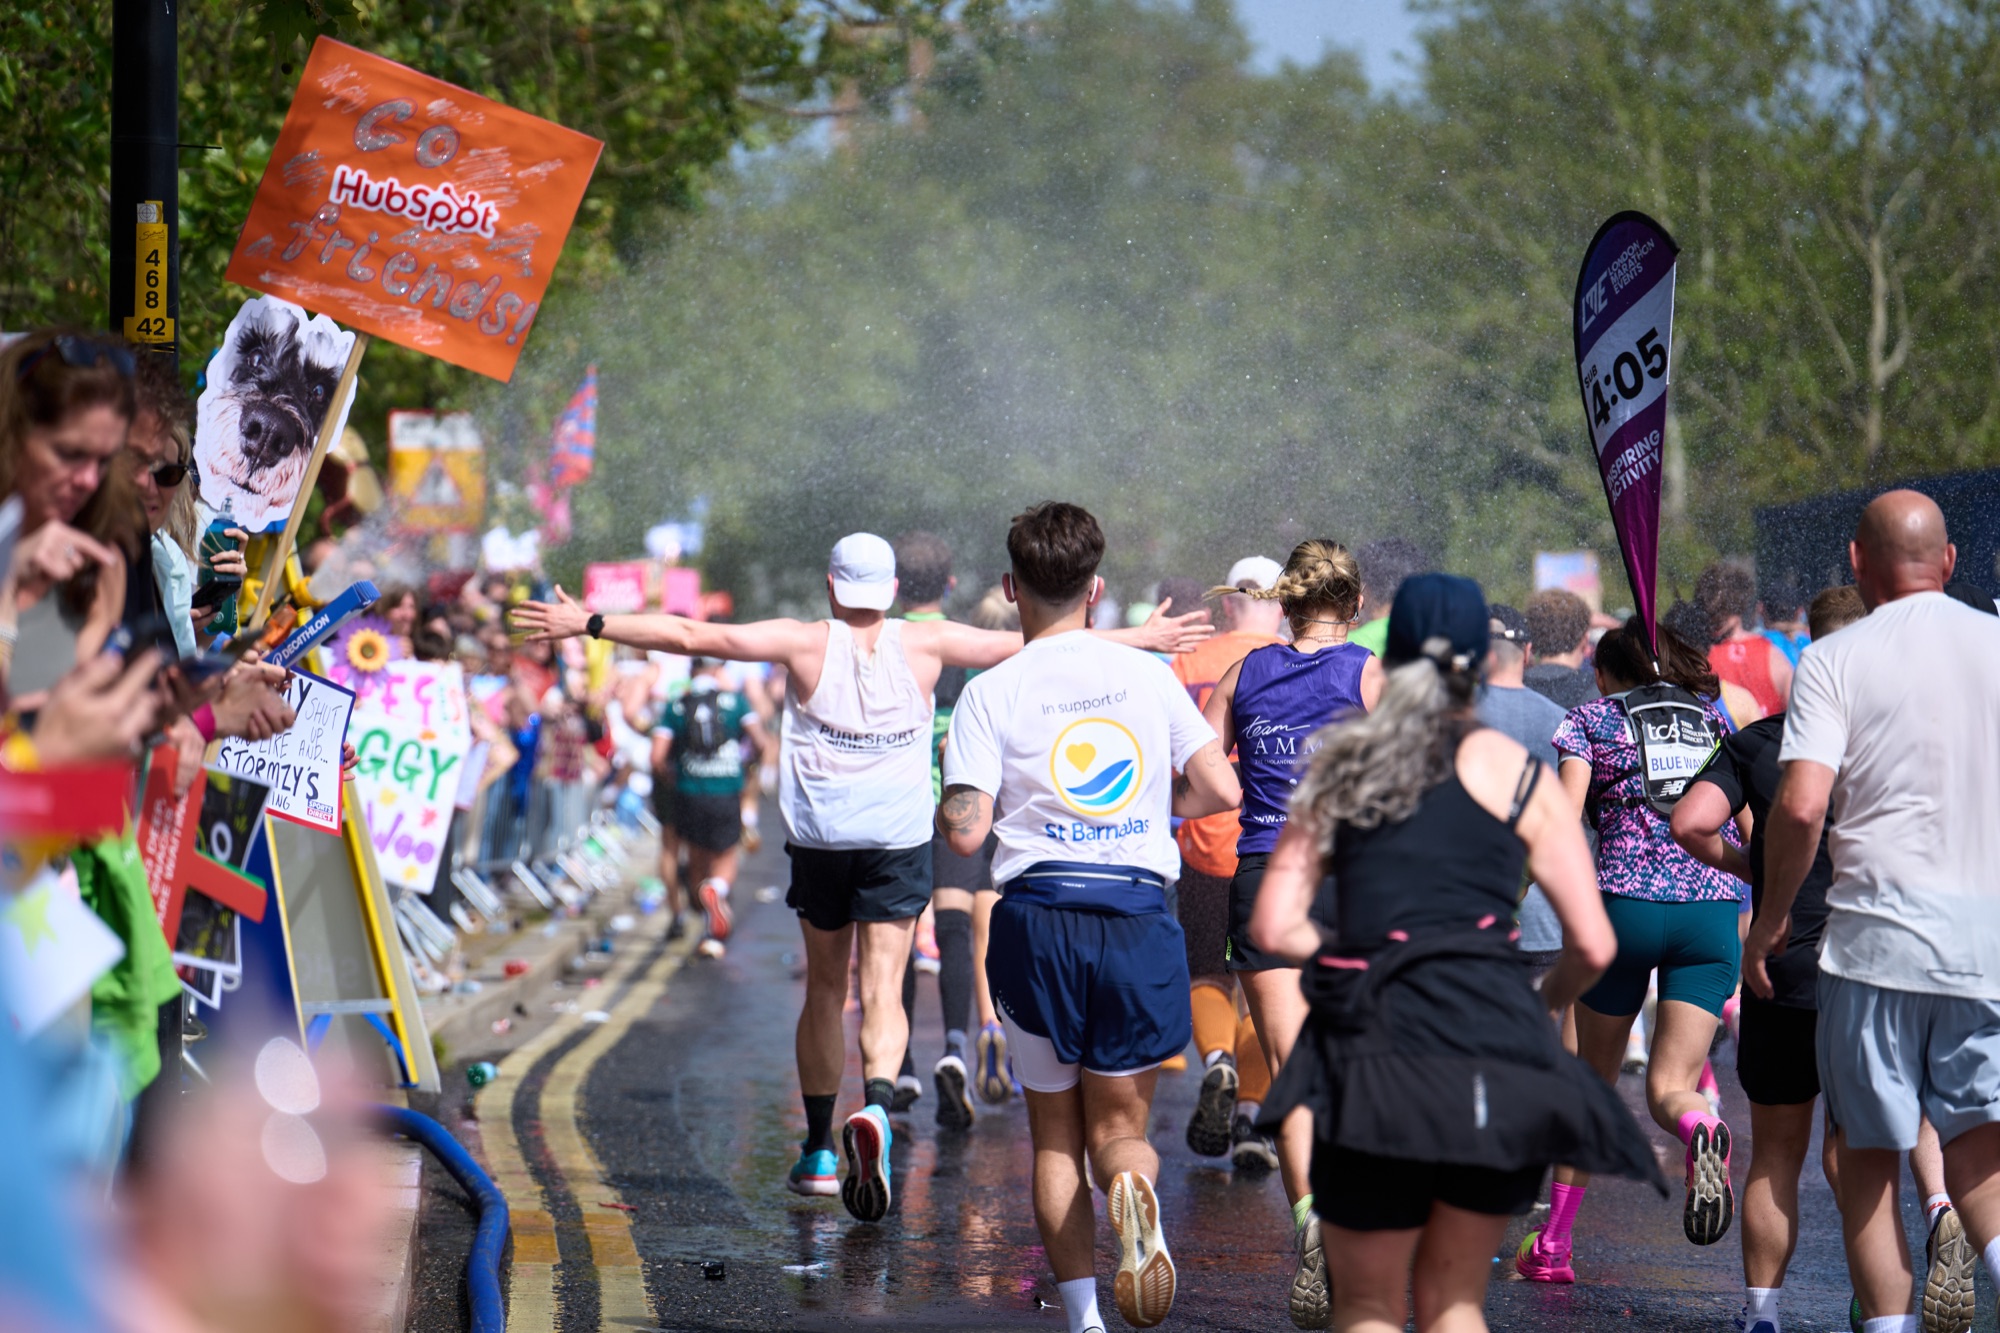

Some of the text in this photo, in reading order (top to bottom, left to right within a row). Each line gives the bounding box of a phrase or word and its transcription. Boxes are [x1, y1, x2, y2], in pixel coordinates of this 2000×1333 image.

[333, 169, 495, 235] HubSpot
[145, 249, 160, 267] 4
[1608, 240, 1640, 276] LONDON
[1610, 239, 1655, 285] MARATHON
[145, 269, 159, 288] 6
[281, 202, 538, 345] friends!
[1613, 262, 1643, 295] EVENTS
[145, 290, 159, 309] 8
[136, 317, 166, 336] 42
[1584, 364, 1598, 388] SUB
[1592, 326, 1668, 429] 4:05
[1606, 429, 1660, 491] INSPIRING
[1611, 447, 1660, 505] ACTIVITY
[282, 614, 330, 660] DECATHLON
[305, 697, 343, 729] SHUT
[1042, 689, 1128, 715] In support of
[310, 727, 324, 746] UP
[1242, 715, 1311, 740] team
[1680, 720, 1694, 730] TATA
[1682, 734, 1704, 743] SERVICES
[217, 746, 320, 800] STORMZY'S
[1651, 755, 1683, 772] BLUE
[307, 808, 333, 822] DIRECT
[308, 801, 334, 813] SPORTS
